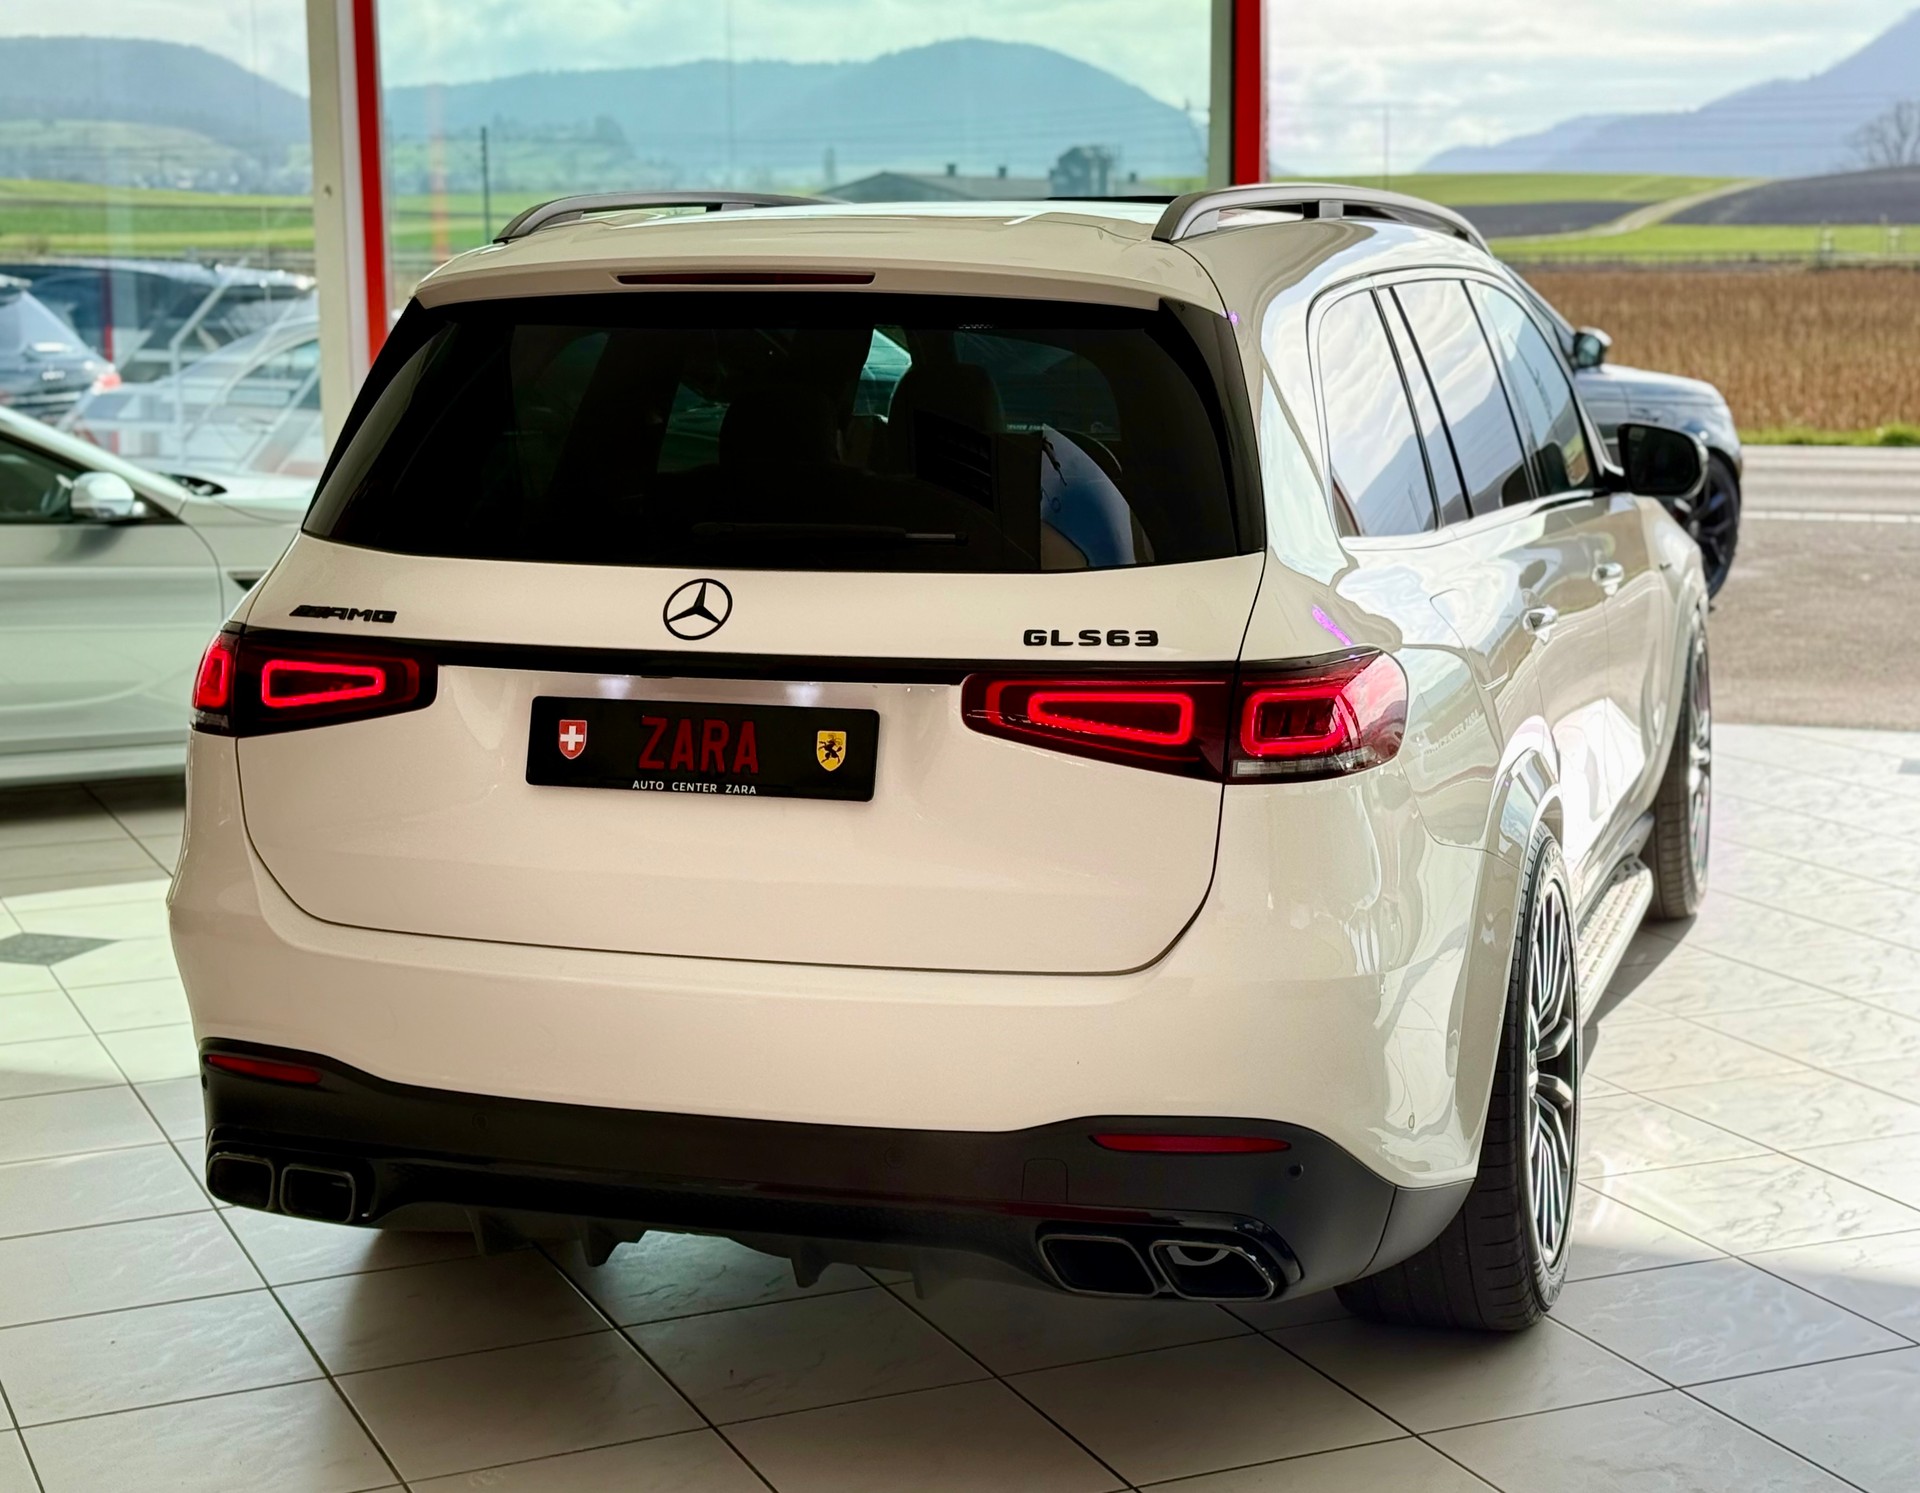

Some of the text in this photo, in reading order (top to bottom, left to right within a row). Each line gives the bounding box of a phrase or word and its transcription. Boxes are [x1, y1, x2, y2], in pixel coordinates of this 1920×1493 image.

[318, 606, 398, 623] AMG
[1023, 629, 1159, 647] GLS63
[638, 716, 759, 774] ZARA
[632, 780, 757, 795] AUTO CENTER ZARA
